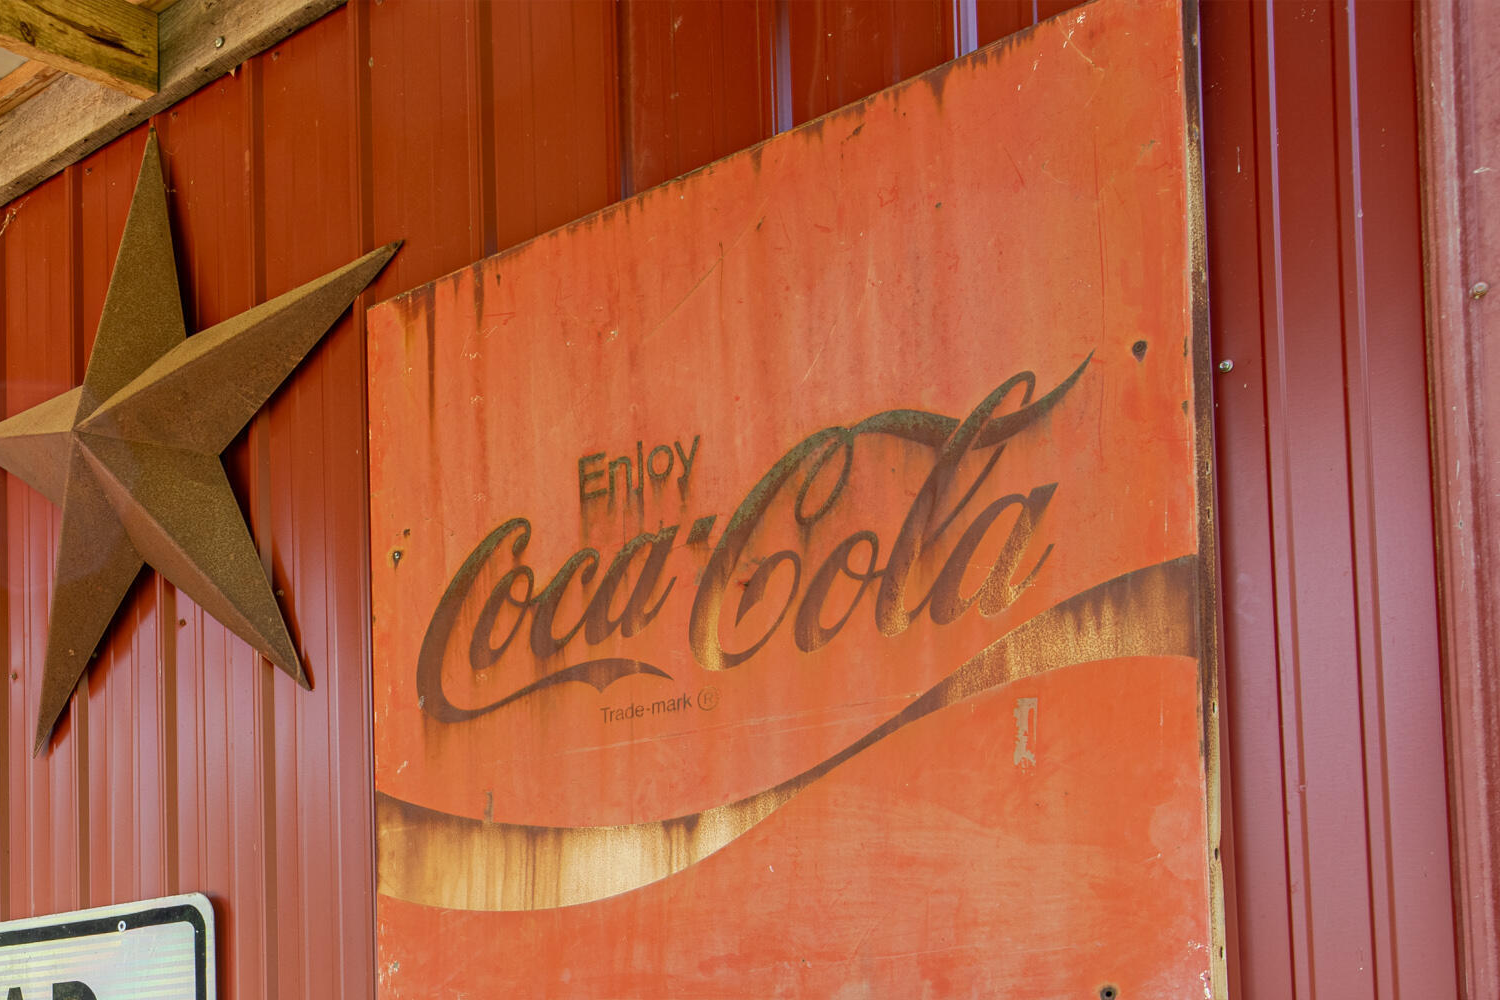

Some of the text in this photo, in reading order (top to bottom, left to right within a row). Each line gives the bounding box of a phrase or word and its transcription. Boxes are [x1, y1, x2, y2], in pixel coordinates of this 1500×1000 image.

[578, 436, 700, 504] Enjoy
[417, 348, 1094, 723] Coca-Cola
[600, 692, 693, 724] Trade-mark
